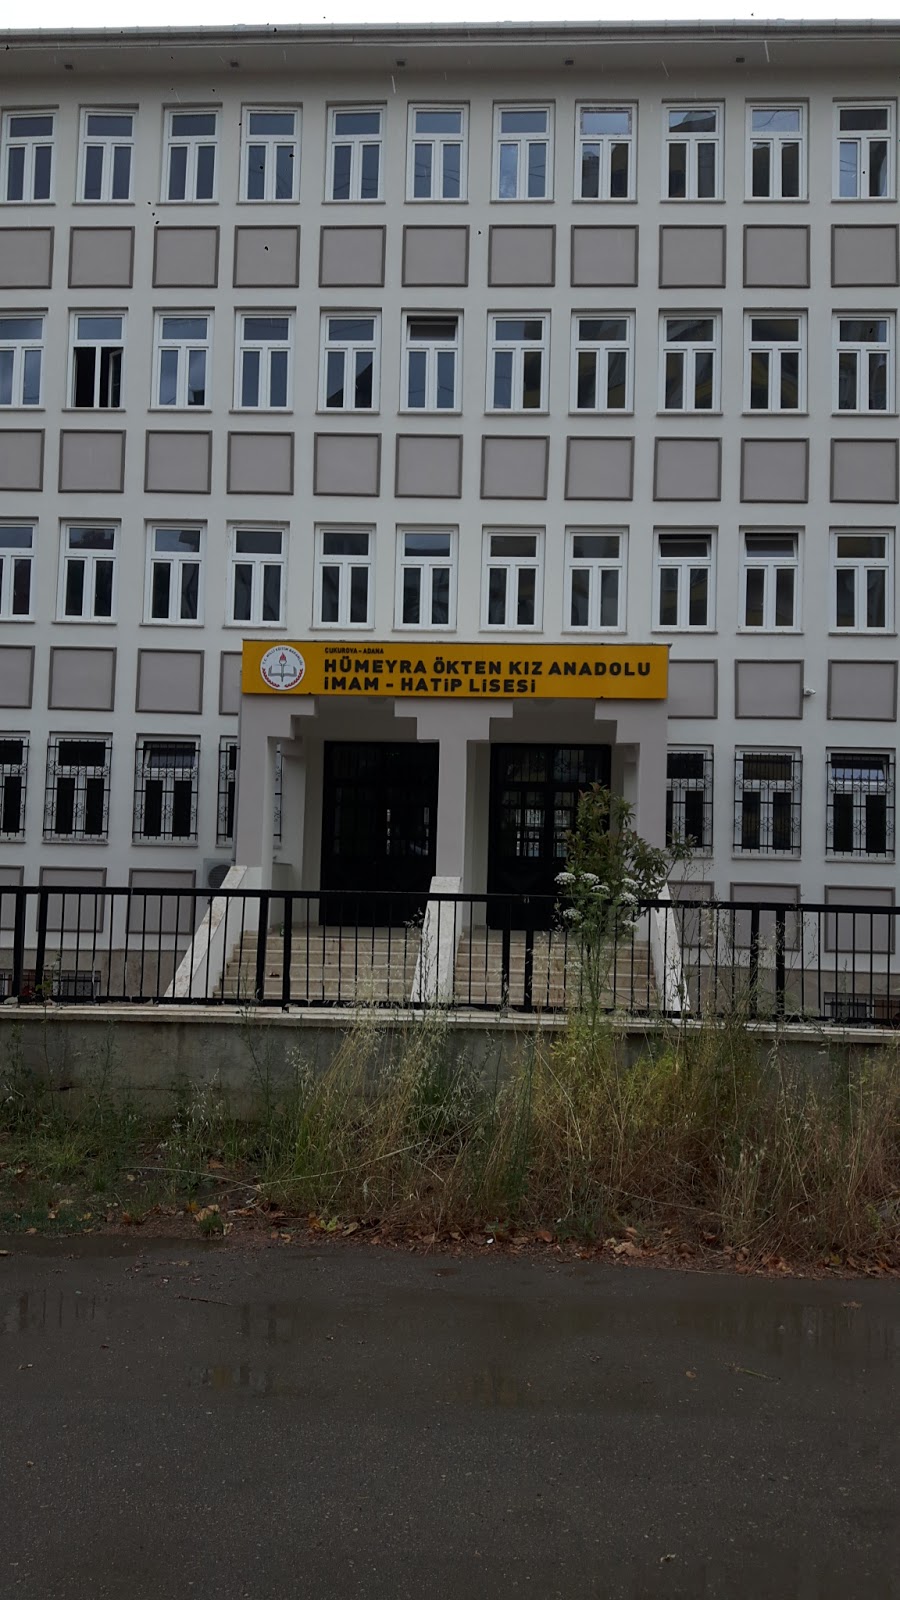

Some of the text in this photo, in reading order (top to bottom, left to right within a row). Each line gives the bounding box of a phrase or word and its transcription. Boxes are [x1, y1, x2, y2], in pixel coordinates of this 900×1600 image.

[324, 656, 651, 676] HÜMEYRA ÖKTEN KIZ ANADOLU
[324, 676, 379, 690] İMAM
[401, 677, 463, 692] HATİP
[469, 678, 536, 693] LİSESİ
